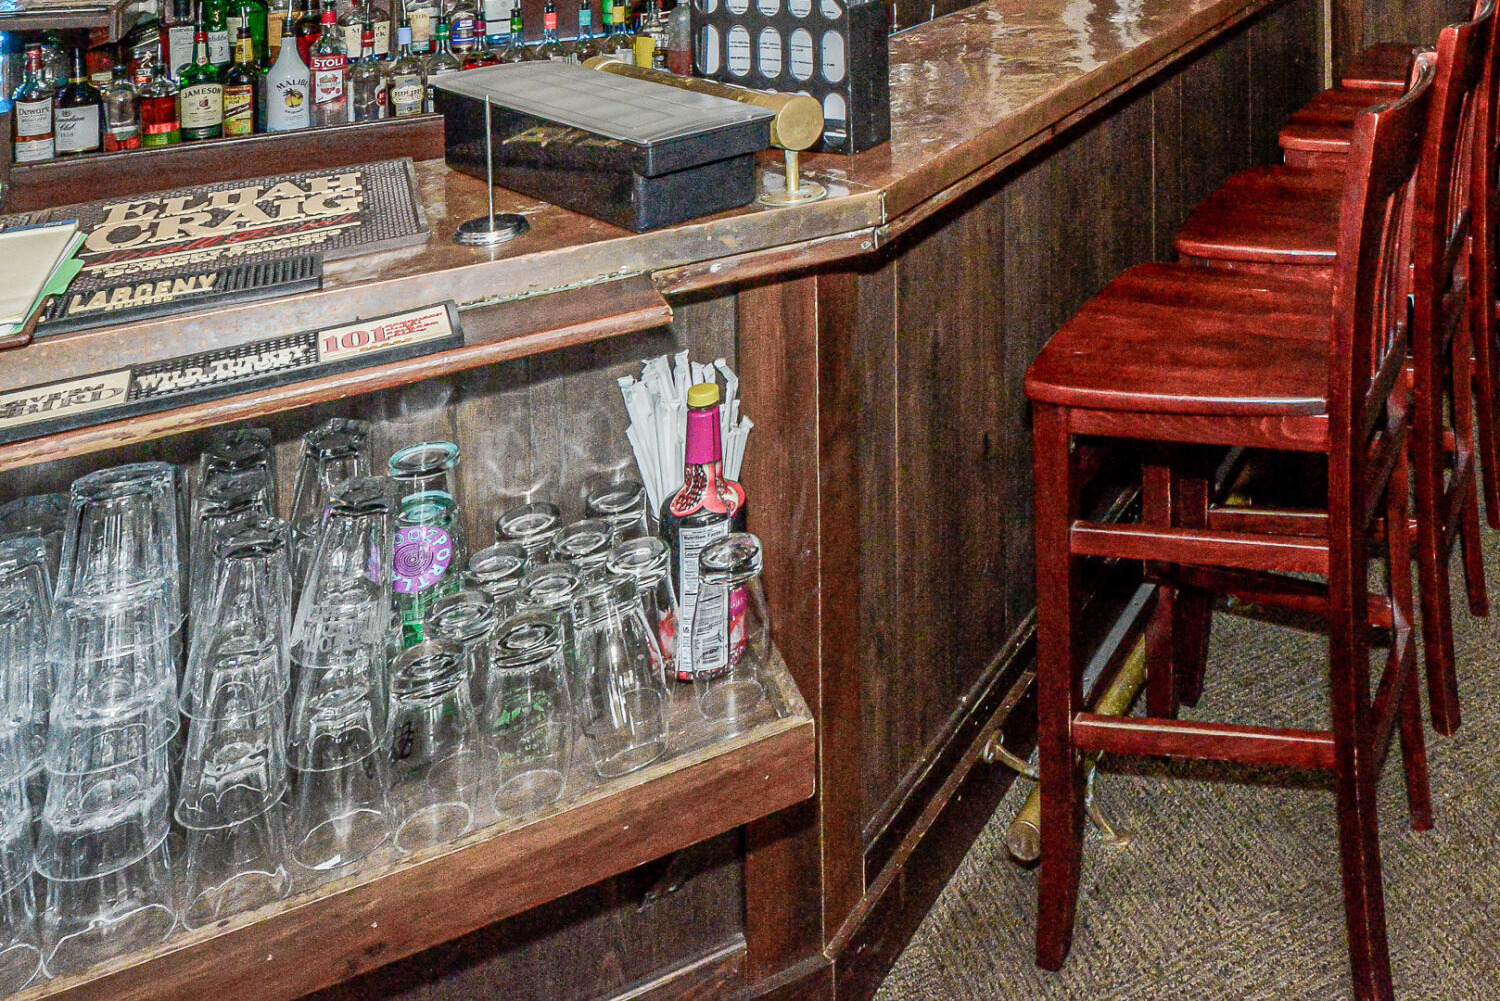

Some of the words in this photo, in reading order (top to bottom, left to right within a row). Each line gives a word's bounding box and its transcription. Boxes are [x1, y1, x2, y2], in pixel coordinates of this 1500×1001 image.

[314, 58, 344, 68] STOLI
[183, 87, 221, 99] JAMESON
[84, 196, 363, 252] CRAIG
[68, 273, 218, 314] LARCENY
[322, 325, 390, 354] 101
